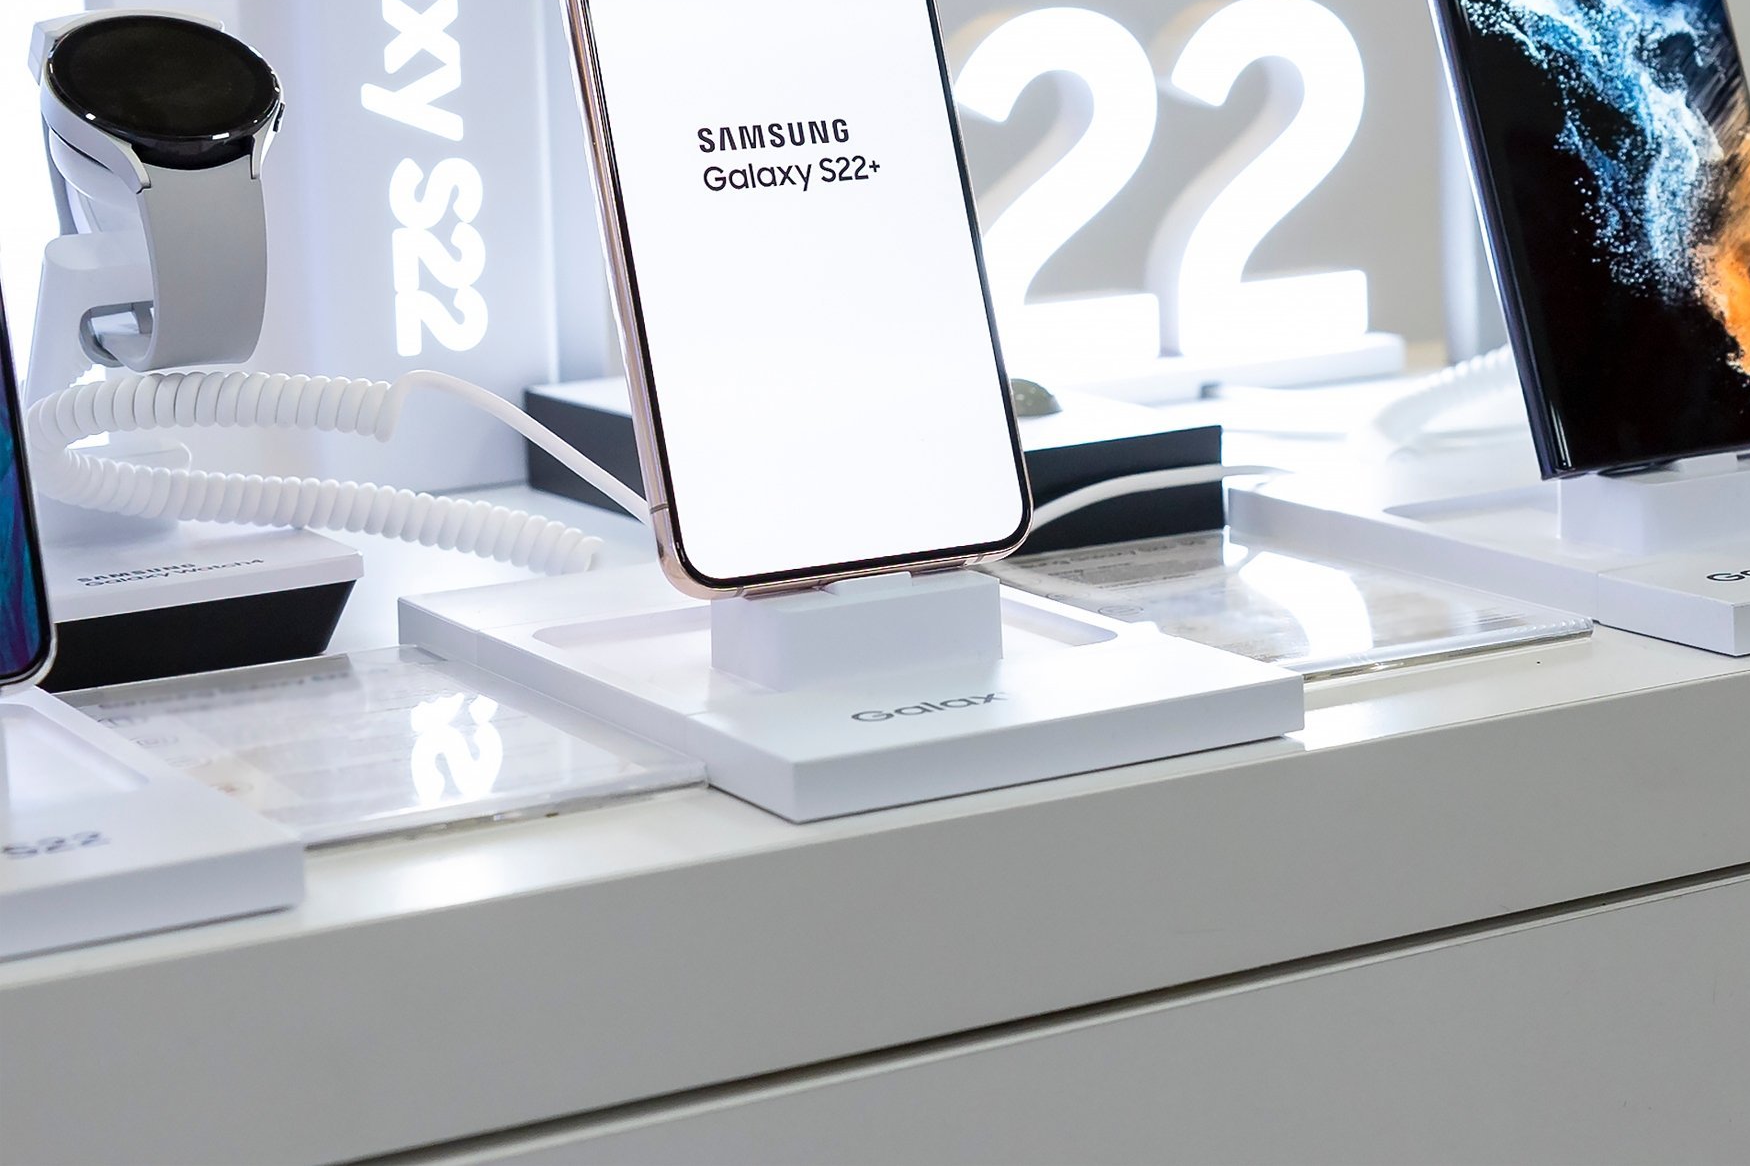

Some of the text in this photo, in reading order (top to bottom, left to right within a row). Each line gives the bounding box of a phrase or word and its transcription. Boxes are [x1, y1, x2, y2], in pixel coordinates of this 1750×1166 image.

[697, 118, 849, 153] SAMSUNG
[703, 155, 880, 192] Galaxy S22+
[388, 156, 490, 358] S22
[77, 562, 195, 583] SAMSUNG
[85, 572, 170, 587] Galaxy
